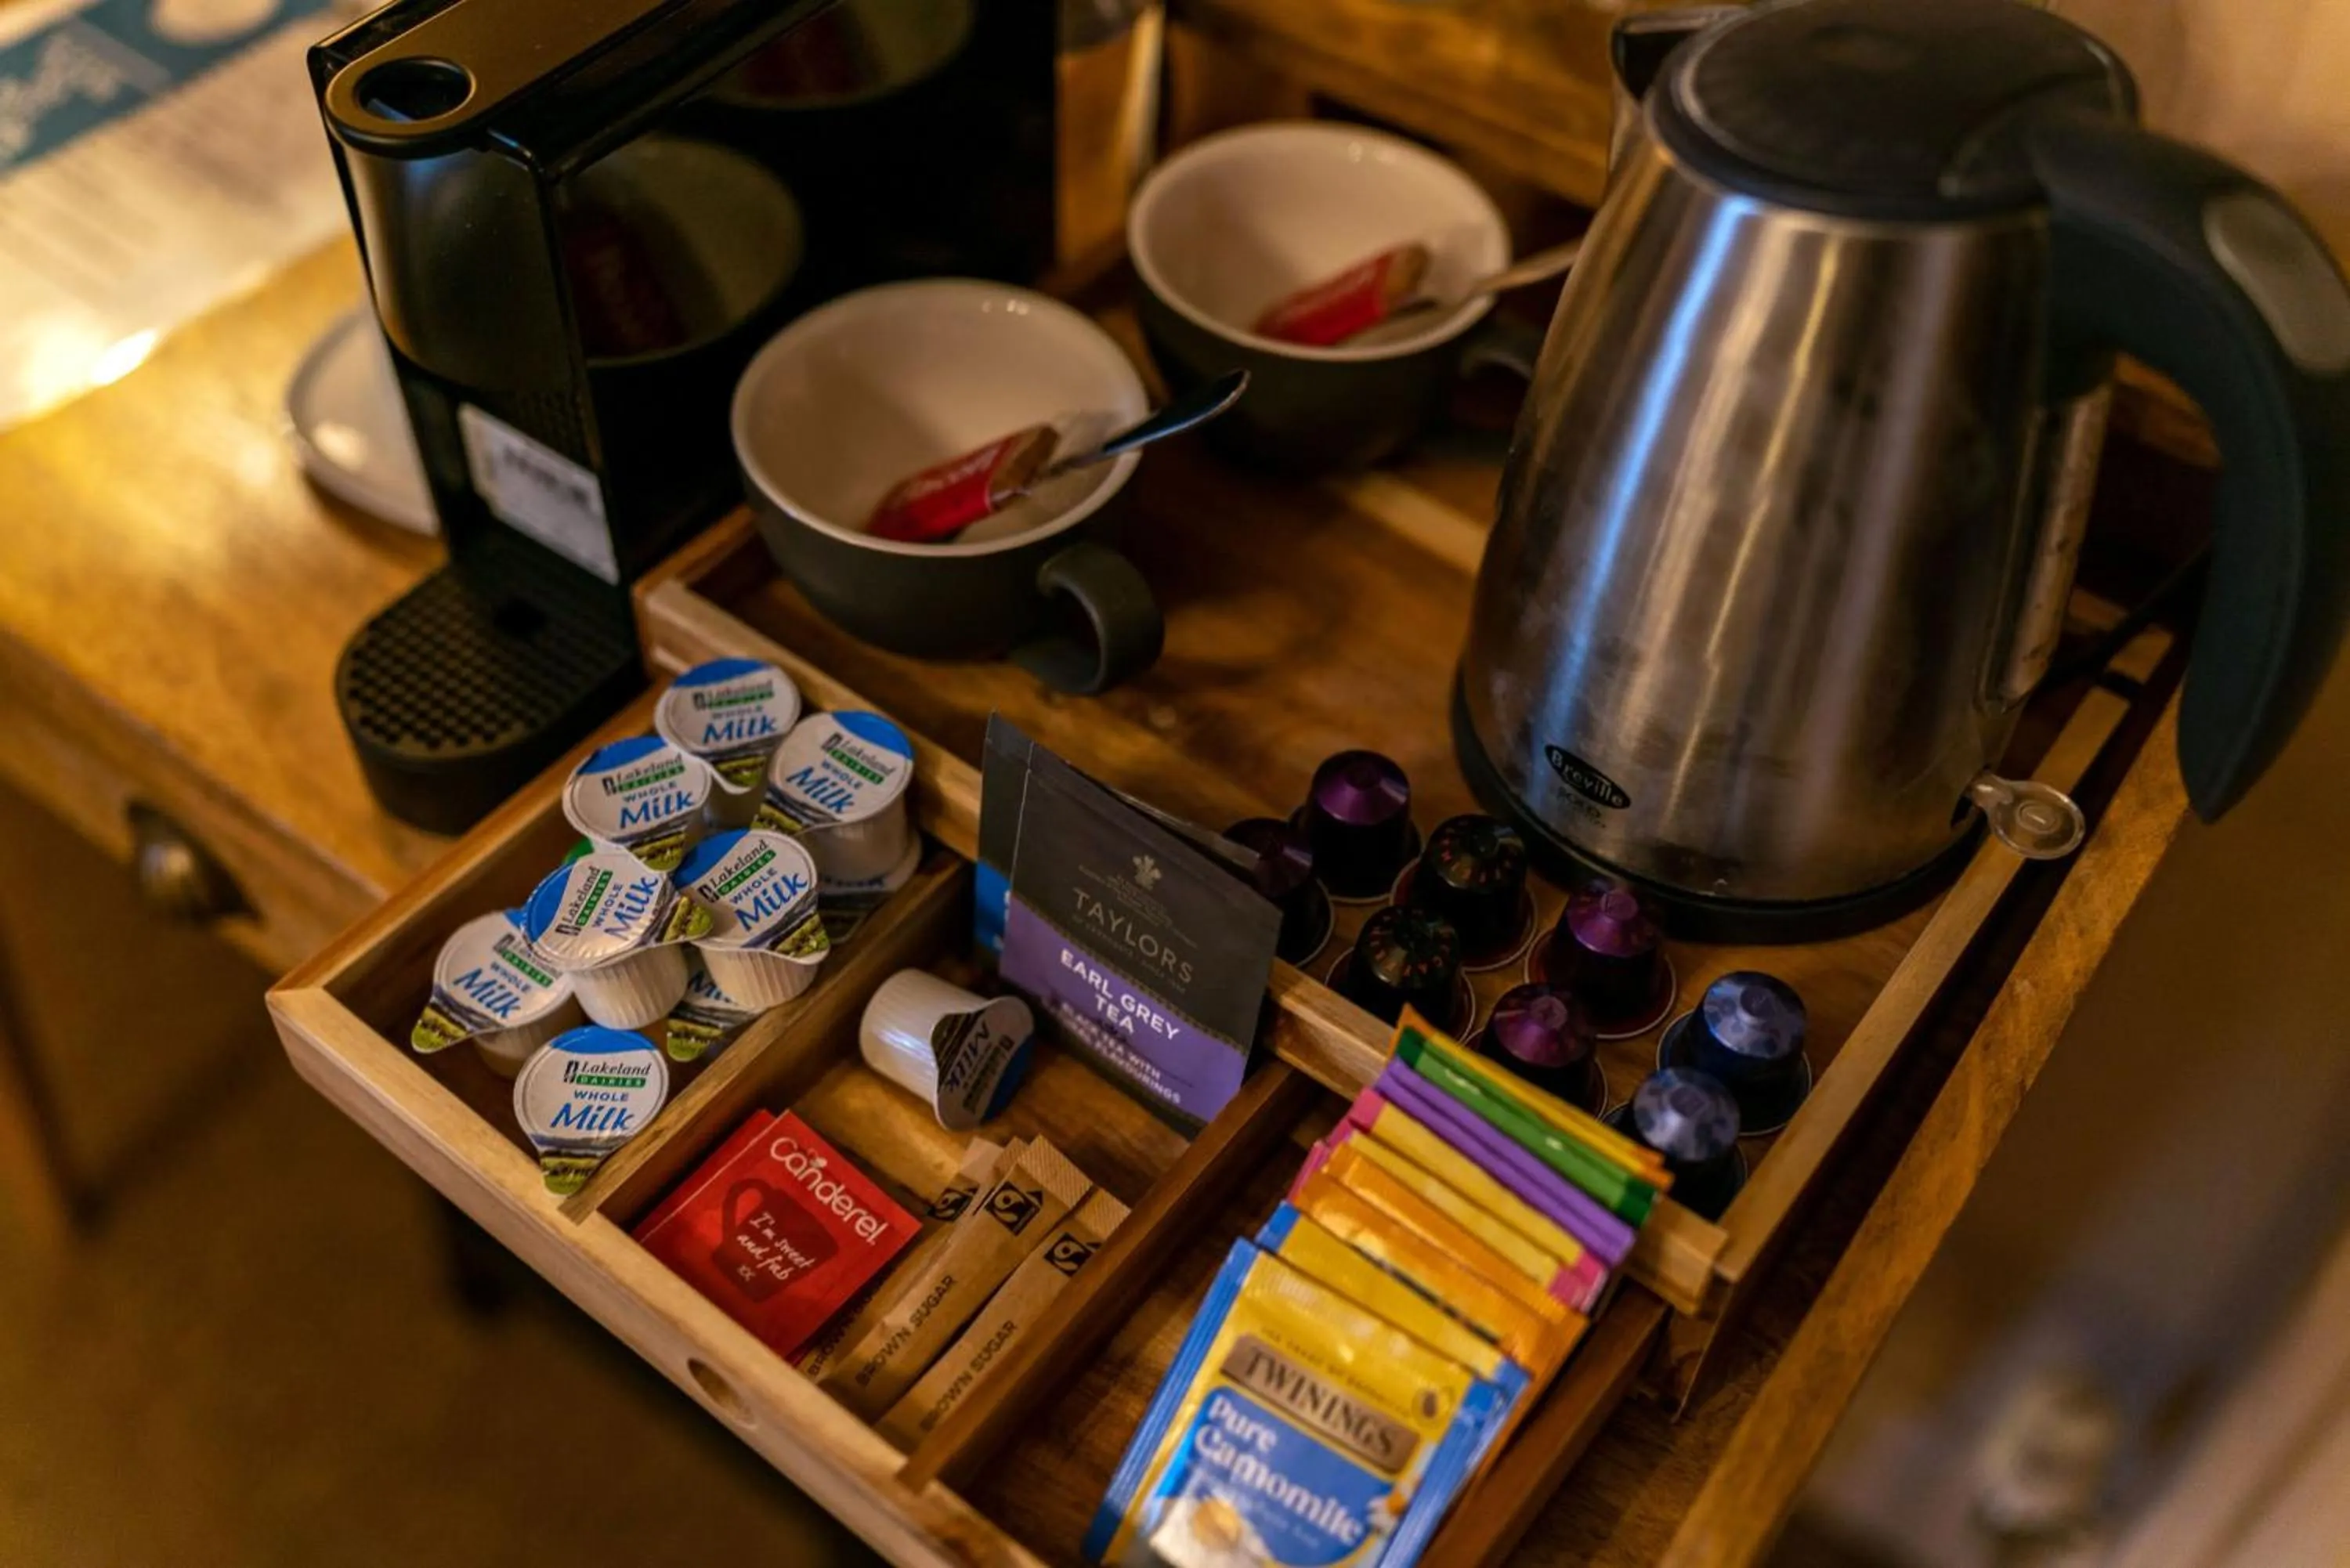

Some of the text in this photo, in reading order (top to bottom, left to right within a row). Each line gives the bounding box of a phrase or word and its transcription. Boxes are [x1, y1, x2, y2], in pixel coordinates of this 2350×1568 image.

[703, 715, 777, 744] Milk
[786, 766, 855, 813] Milk
[1552, 750, 1623, 807] Breville
[620, 790, 695, 829] Milk
[710, 840, 768, 888] Lakeland
[730, 867, 778, 905] WHOLE
[562, 865, 601, 923] Lakeland
[592, 883, 623, 927] WHOLE
[604, 877, 659, 941] Milk
[735, 873, 808, 931] Milk
[1073, 887, 1194, 983] TAYLORS
[453, 968, 521, 1018] Milk
[1061, 948, 1113, 999] EARL
[1120, 994, 1180, 1041] GREY
[1095, 993, 1134, 1035] TEA
[580, 1075, 642, 1086] DAIRIES
[581, 1061, 653, 1076] Lakeland
[946, 1020, 989, 1093] Milk
[1128, 1051, 1161, 1081] WITH
[551, 1102, 635, 1131] Milk
[573, 1089, 630, 1102] WHOLE
[736, 1234, 794, 1281] and fab
[775, 1238, 816, 1269] sweet
[854, 1324, 913, 1387] BROWN
[909, 1275, 957, 1328] SUGAR
[969, 1320, 1018, 1373] SUGAR
[1208, 1394, 1278, 1453] Pure
[1245, 1346, 1394, 1457] TWININGS
[1195, 1422, 1365, 1547] Camomile
